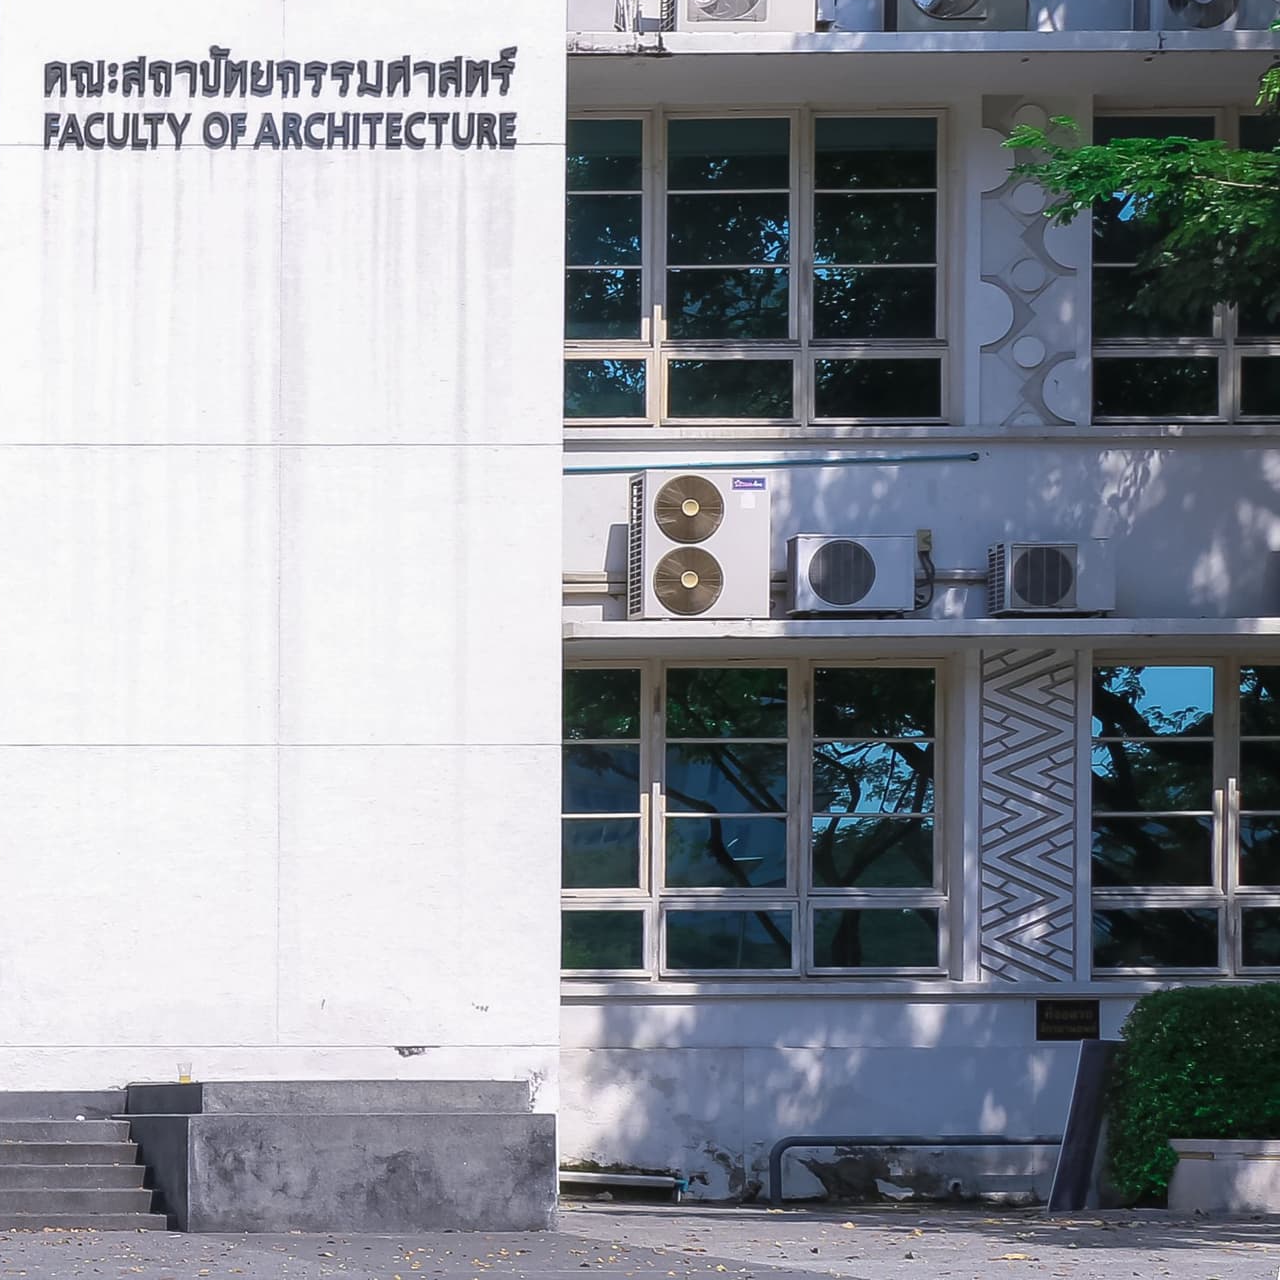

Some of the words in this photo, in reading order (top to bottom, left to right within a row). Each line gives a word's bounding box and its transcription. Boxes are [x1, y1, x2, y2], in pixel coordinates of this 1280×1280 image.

[43, 45, 518, 99] คณะสถาปัตยกรรมศาสตร์
[43, 111, 192, 151] FACULTY
[202, 111, 247, 151] OF
[254, 111, 518, 151] ARCHITECTURE
